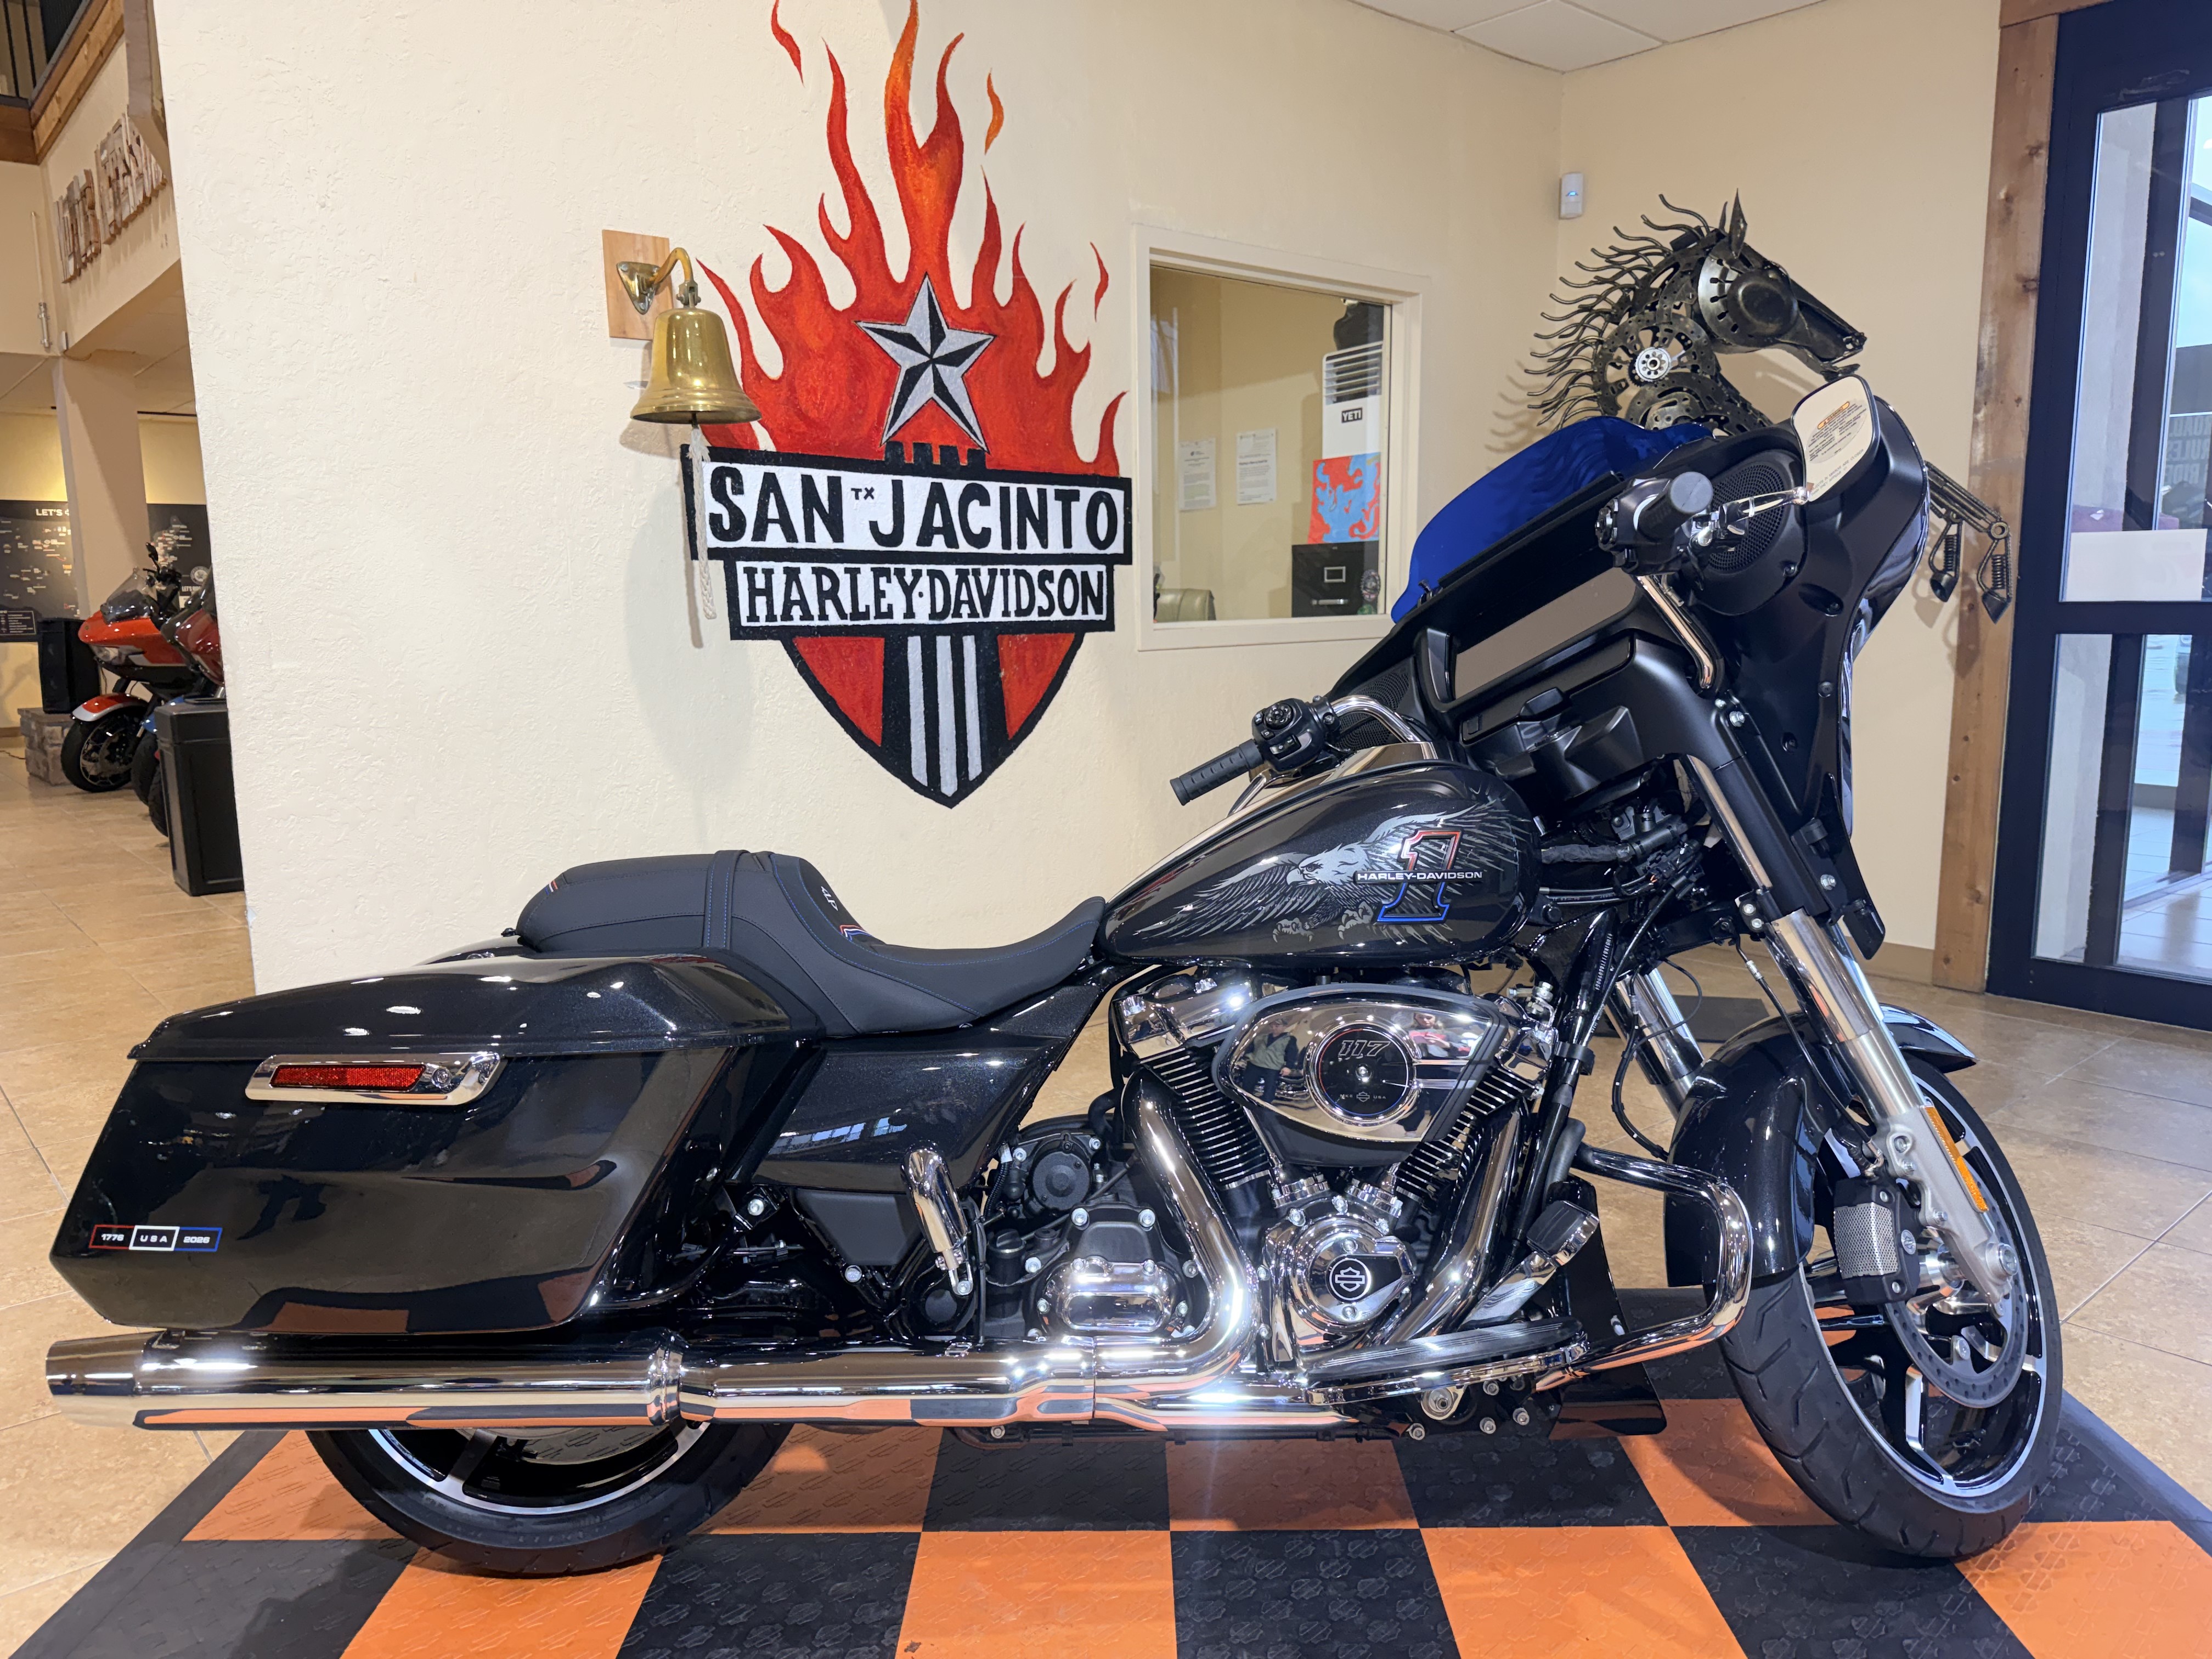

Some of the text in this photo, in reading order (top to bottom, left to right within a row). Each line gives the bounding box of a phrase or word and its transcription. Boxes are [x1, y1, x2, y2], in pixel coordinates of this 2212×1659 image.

[1342, 410, 1361, 421] YETI
[709, 466, 1118, 549] SAN TX JACINTO
[1357, 872, 1482, 881] HARLEY-DAVIDSON
[1339, 1040, 1391, 1057] 117
[101, 1233, 125, 1242] 1776
